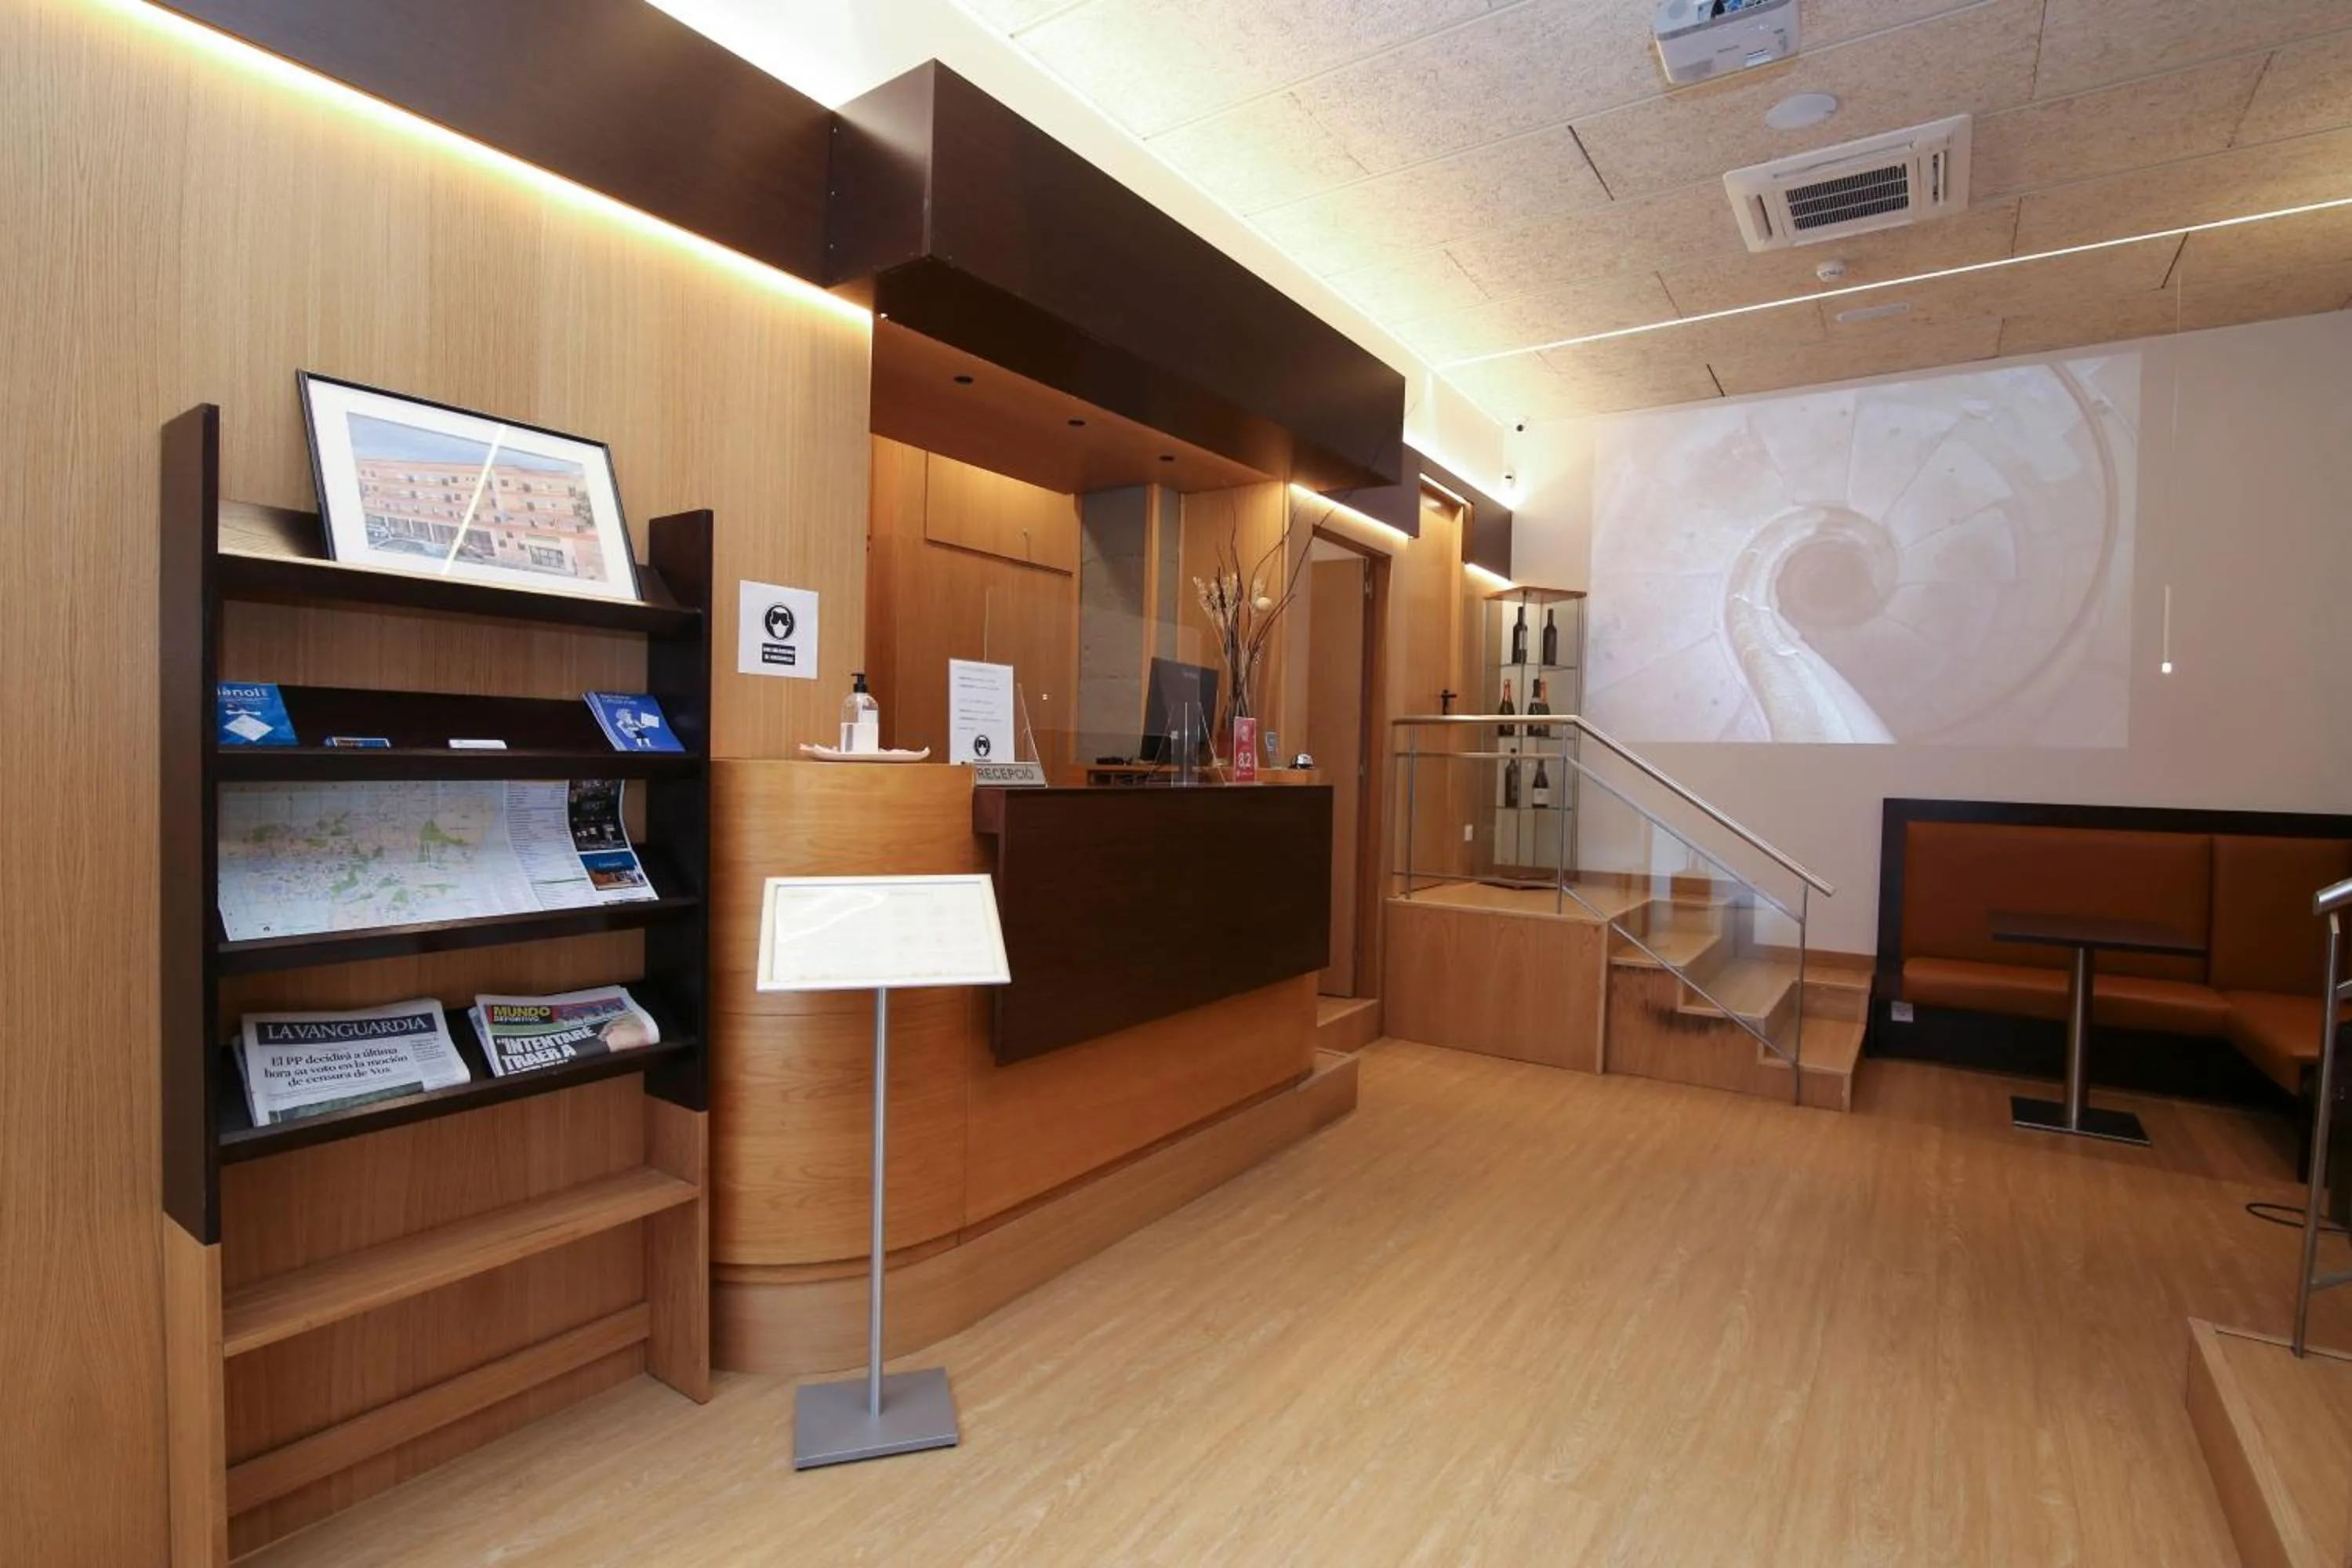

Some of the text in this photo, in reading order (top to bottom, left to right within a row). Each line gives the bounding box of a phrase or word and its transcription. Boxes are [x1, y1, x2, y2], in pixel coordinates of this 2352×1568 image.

[493, 1006, 550, 1018] MUNDO
[267, 1017, 427, 1040] LA VANGUARDIA
[264, 1068, 292, 1078] hora
[293, 1069, 309, 1077] su
[310, 1064, 337, 1074] voto
[354, 1058, 365, 1068] la
[367, 1054, 409, 1067] moción
[271, 1057, 283, 1067] El
[285, 1056, 303, 1066] PP
[305, 1050, 353, 1065] decidirá
[362, 1047, 398, 1058] última
[502, 1048, 561, 1071] TRAER
[564, 1044, 577, 1058] A
[288, 1065, 392, 1087] de censura de Vox
